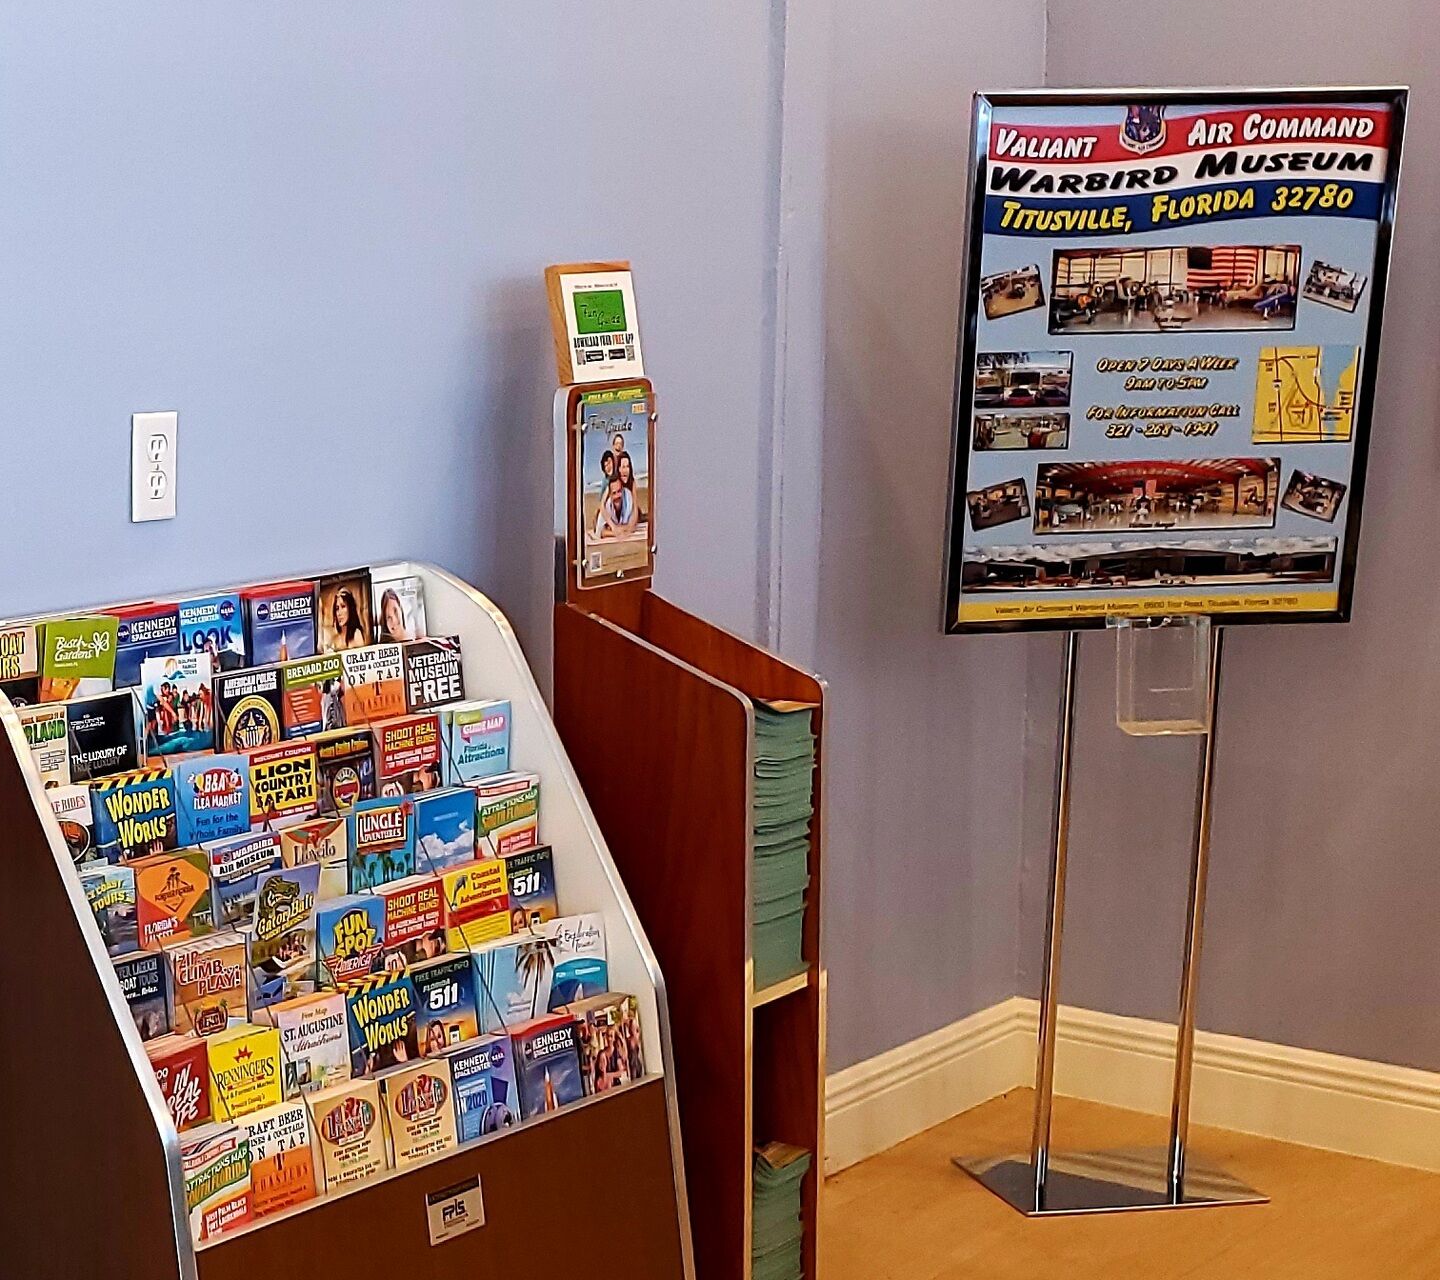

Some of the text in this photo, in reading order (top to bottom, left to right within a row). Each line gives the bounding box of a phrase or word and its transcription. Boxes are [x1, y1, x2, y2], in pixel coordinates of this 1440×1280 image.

[1188, 113, 1374, 147] AIR COMMAND
[996, 129, 1096, 158] VALIANT
[990, 151, 1374, 194] WARBIRD MUSEUM
[999, 183, 1354, 232] TITUSVILLE, FLORIDA 32780
[612, 333, 625, 345] FREE
[625, 332, 634, 345] APP
[1097, 355, 1239, 372] OPEN 7 DAYS A WEEK
[1124, 376, 1155, 391] 9AM
[1175, 376, 1208, 389] 5PM
[1086, 404, 1240, 419] FOR INFORMATION CALL
[1105, 424, 1132, 437] 321
[180, 604, 218, 618] KENNEDY
[270, 596, 311, 612] KENNEDY
[270, 607, 312, 621] SPACE CENTER
[131, 616, 176, 632] KENNEDY
[131, 627, 177, 643] SPACE CENTER
[182, 624, 233, 651] LOOK
[54, 649, 93, 661] Gardens
[346, 646, 400, 665] CRAFT BEER
[408, 650, 458, 668] VETERANS
[256, 671, 277, 684] POLICE
[287, 658, 339, 679] BREVARD ZOO
[348, 666, 400, 686] ON TAP
[409, 660, 459, 683] MUSEUM
[410, 675, 461, 706] FREE
[385, 721, 436, 742] SHOOT REAL
[89, 747, 116, 762] LUXURY
[117, 745, 128, 755] OF
[285, 746, 312, 756] COUPON
[458, 746, 506, 765] Attractions
[464, 742, 488, 753] Florida
[255, 758, 312, 781] LION
[255, 771, 313, 794] COUNTRY
[105, 786, 170, 823] WONDER
[211, 792, 242, 808] MARKET
[256, 785, 313, 808] SAFARI
[227, 813, 239, 822] the
[360, 812, 402, 833] JUNGLE
[117, 815, 168, 849] WORKS
[233, 837, 273, 860] WARBIRD
[236, 849, 275, 868] MUSEUM
[471, 866, 500, 881] Coastal
[473, 877, 501, 890] Lagoon
[513, 872, 540, 897] 511
[93, 892, 125, 912] TOURS
[387, 887, 439, 911] SHOOT REAL
[460, 887, 502, 905] Adventures
[144, 916, 178, 935] FLORIDA'S
[334, 911, 368, 943] FUN
[336, 929, 377, 958] SPOT
[335, 954, 372, 973] AMERICA
[454, 960, 469, 972] INFO
[198, 971, 241, 996] PLAY!
[429, 983, 458, 1010] 511
[315, 1007, 327, 1018] Map
[352, 988, 410, 1029] WONDER
[284, 1013, 344, 1042] ST. AUGUSTINE
[364, 1014, 409, 1055] WORKS
[532, 1027, 572, 1049] KENNEDY
[550, 1039, 574, 1053] CENTER
[453, 1052, 490, 1072] KENNEDY
[471, 1062, 491, 1074] CENTER
[174, 1064, 191, 1094] IN
[216, 1056, 275, 1091] RENNINGERS
[231, 1148, 248, 1163] MAP
[249, 1146, 266, 1163] ON
[278, 1132, 306, 1151] TAP
